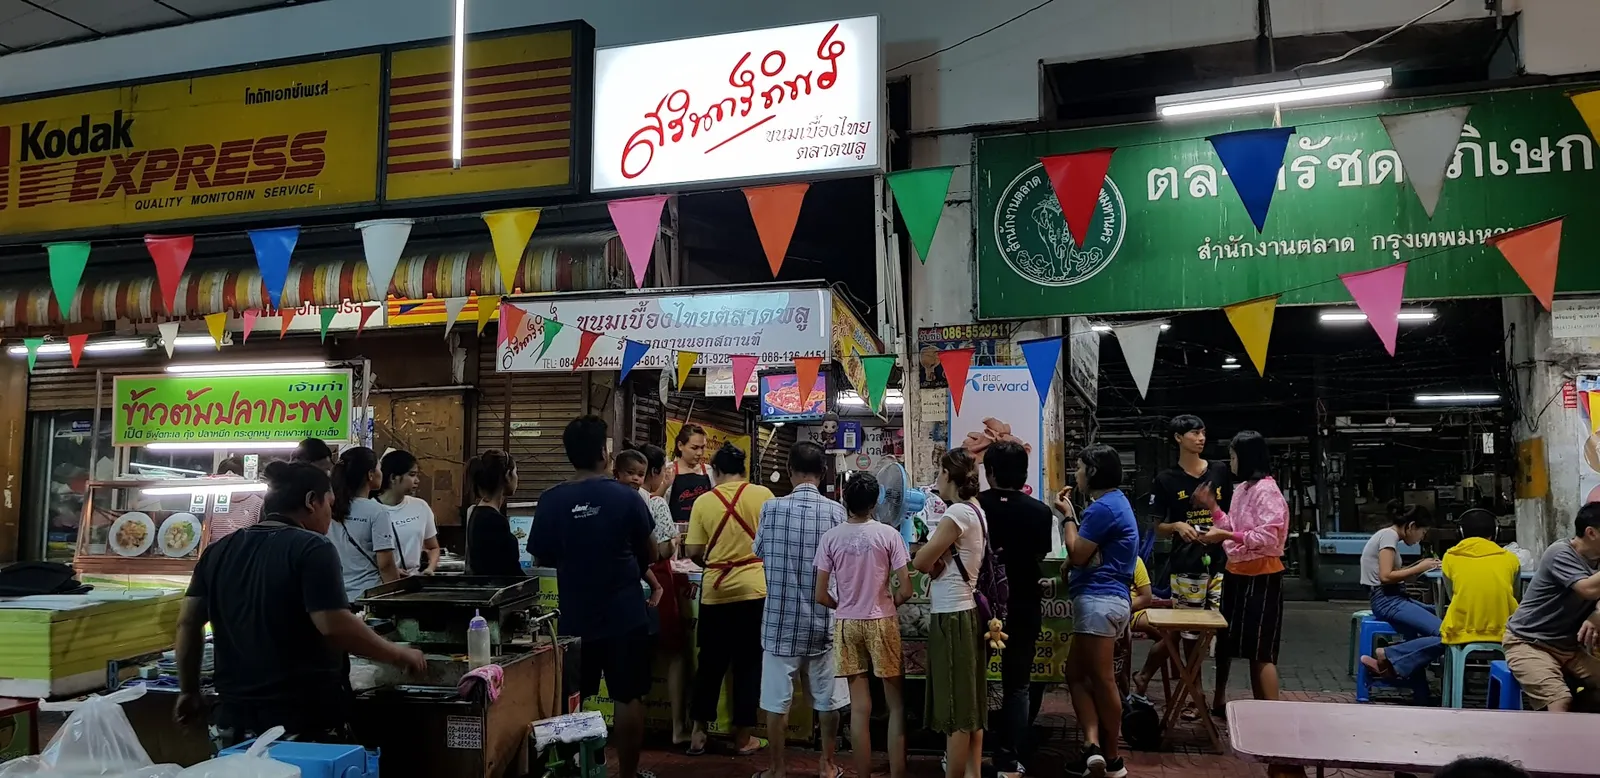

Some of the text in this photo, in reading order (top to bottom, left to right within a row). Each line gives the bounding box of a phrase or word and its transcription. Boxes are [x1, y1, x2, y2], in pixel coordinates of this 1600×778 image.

[20, 109, 135, 162] Kodak
[766, 114, 872, 142] ขนมเบื้องไทย
[796, 141, 867, 161] ตลาดพลู
[1147, 124, 1594, 201] ตลรัชดภิเษก
[68, 130, 328, 203] EXPRESS
[135, 183, 316, 210] QUALITY MONITORIN SERVICE
[999, 174, 1042, 253] สำนักงานตลาด
[1197, 226, 1515, 261] สำนักงานตลาด กรุงเทพมห
[577, 300, 811, 332] ขนมเบื้องไทยตลาดพลู
[942, 324, 1010, 340] 086-5529211
[542, 358, 557, 369] TEL:
[288, 380, 343, 393] เจ้าเก่า
[982, 373, 1001, 382] dtac
[982, 380, 1029, 392] reward
[122, 387, 343, 427] ข้าวต้มปลากะพง
[123, 427, 143, 439] เป็ด
[395, 516, 420, 526] ENCHY
[1186, 508, 1212, 519] Standar
